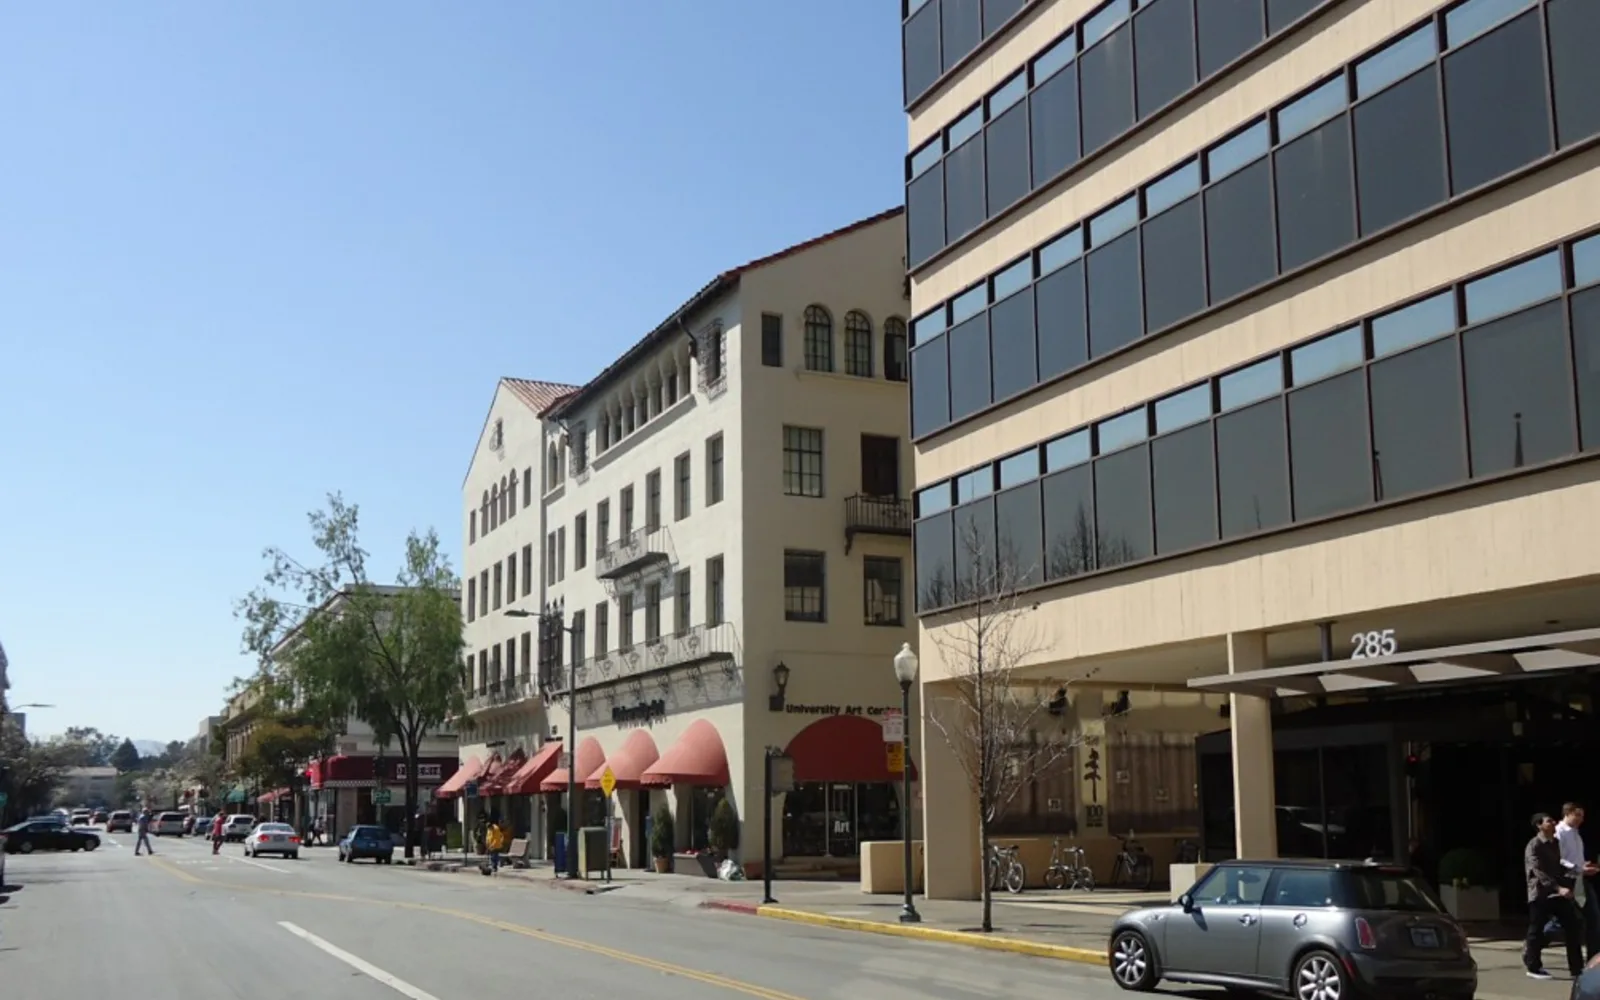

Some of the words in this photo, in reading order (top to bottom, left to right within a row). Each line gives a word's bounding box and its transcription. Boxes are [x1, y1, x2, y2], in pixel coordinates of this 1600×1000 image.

[1351, 629, 1396, 660] 285
[786, 704, 840, 716] University
[845, 704, 862, 715] Art
[867, 706, 902, 715] Cen
